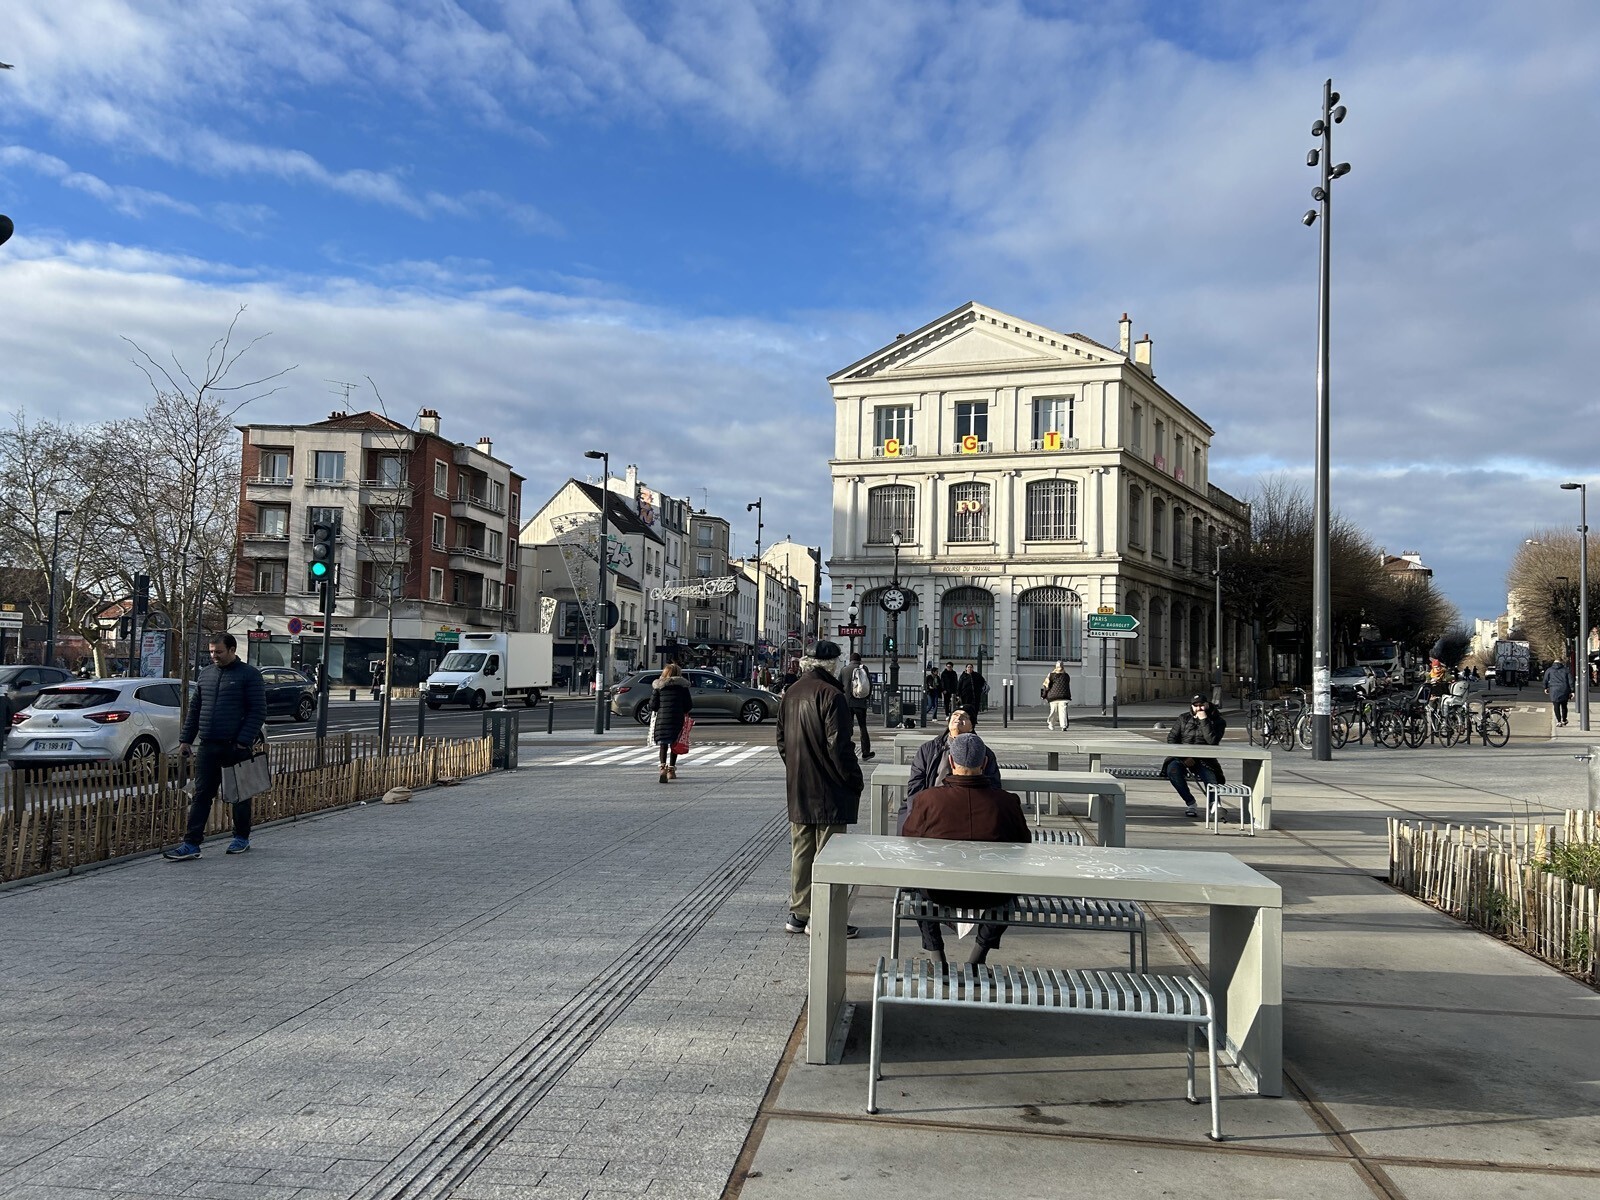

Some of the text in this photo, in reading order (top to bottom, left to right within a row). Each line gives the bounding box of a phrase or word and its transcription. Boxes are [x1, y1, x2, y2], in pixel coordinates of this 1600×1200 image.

[885, 432, 1058, 453] C G T
[955, 500, 982, 514] FO
